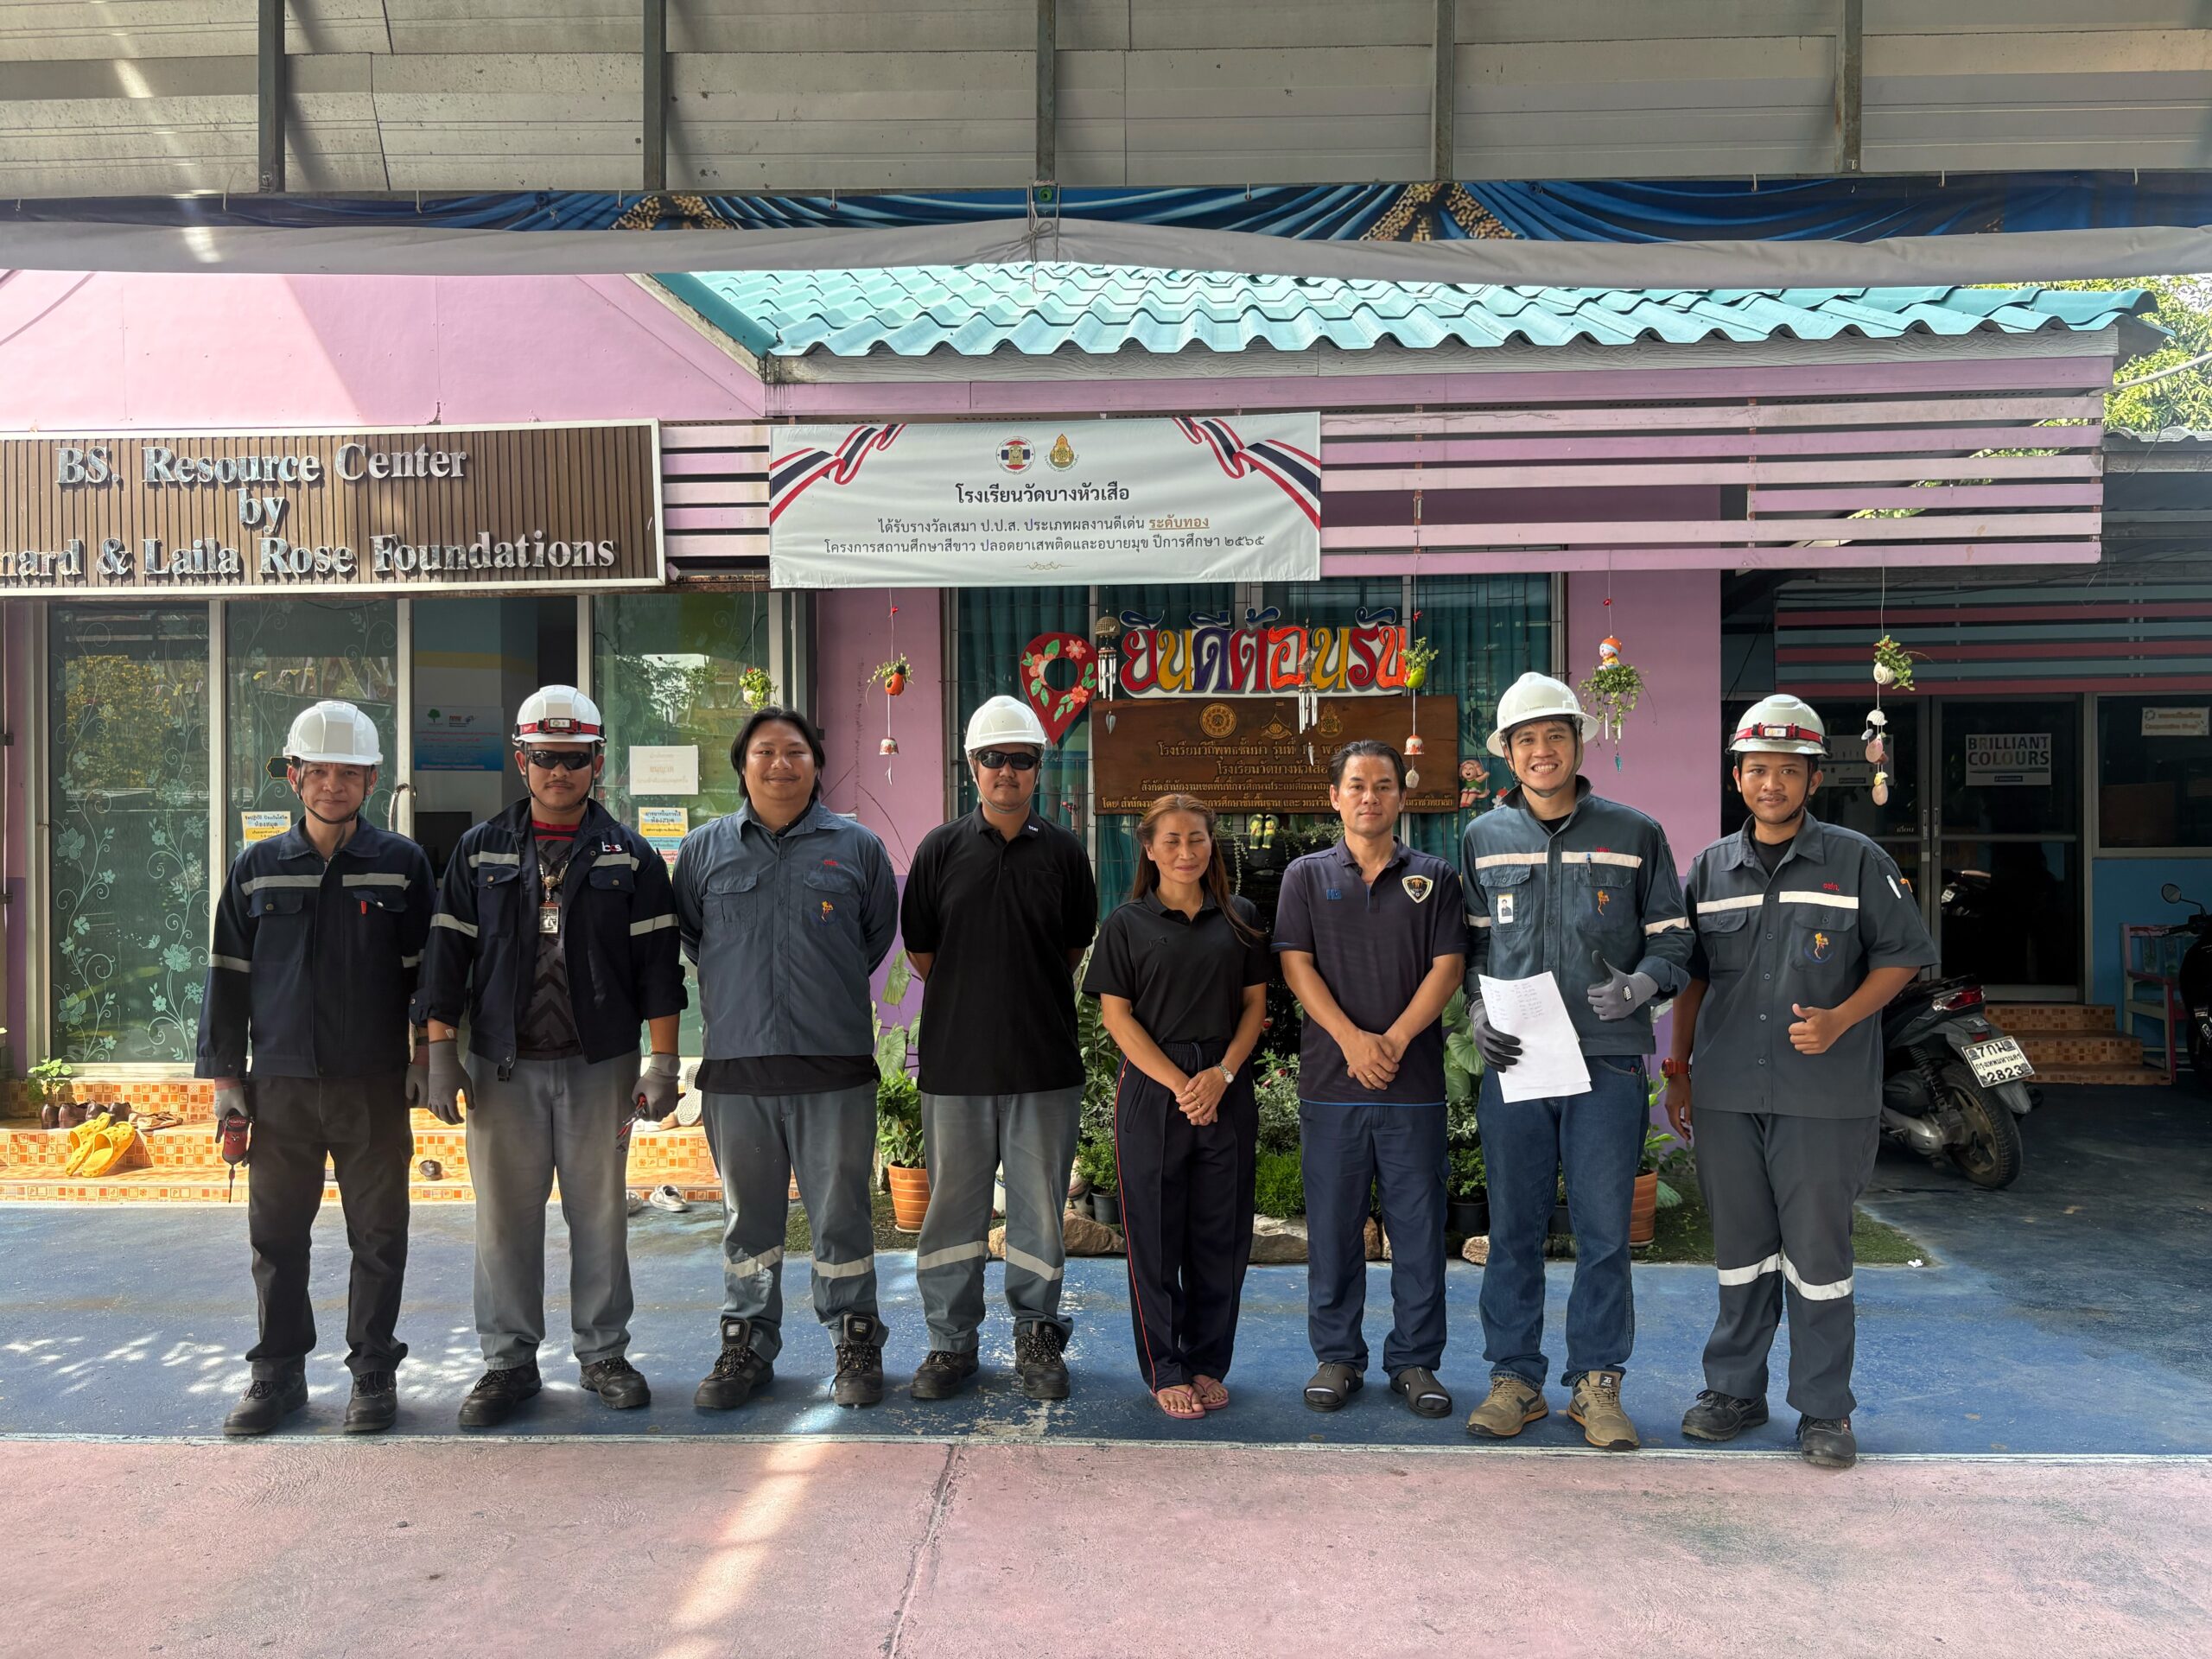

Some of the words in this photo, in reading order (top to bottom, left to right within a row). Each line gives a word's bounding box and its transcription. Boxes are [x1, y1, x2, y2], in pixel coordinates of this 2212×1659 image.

[55, 445, 121, 484] BS.
[142, 445, 321, 484] Resource
[335, 442, 467, 480] Center
[955, 480, 1130, 504] โรงเรียนวัดบางหัวเสือ
[238, 488, 285, 534] by
[878, 518, 976, 534] ได้รับรางวัลเสมา
[981, 518, 1020, 532] ป.ป.ส.
[1024, 516, 1145, 532] ประเภทผลงานดีเด่น
[1149, 513, 1210, 530] ระดับทอง
[97, 537, 133, 575] &
[142, 537, 241, 575] Laila
[257, 537, 357, 575] Rose
[370, 530, 616, 574] Foundations
[824, 537, 976, 553] โครงการสถานศึกษาสีขาว
[981, 535, 1149, 553] ปลอดยาเสพติดและอบายมุข
[1153, 534, 1221, 550] ปีการศึกษา
[1224, 535, 1265, 547] ๒๕๖๕
[1120, 607, 1408, 694] ยินดีต้อนรับ
[1967, 736, 2048, 750] BRILLIANT
[1967, 751, 2050, 766] COLOURS
[1986, 1064, 2024, 1084] 2823
